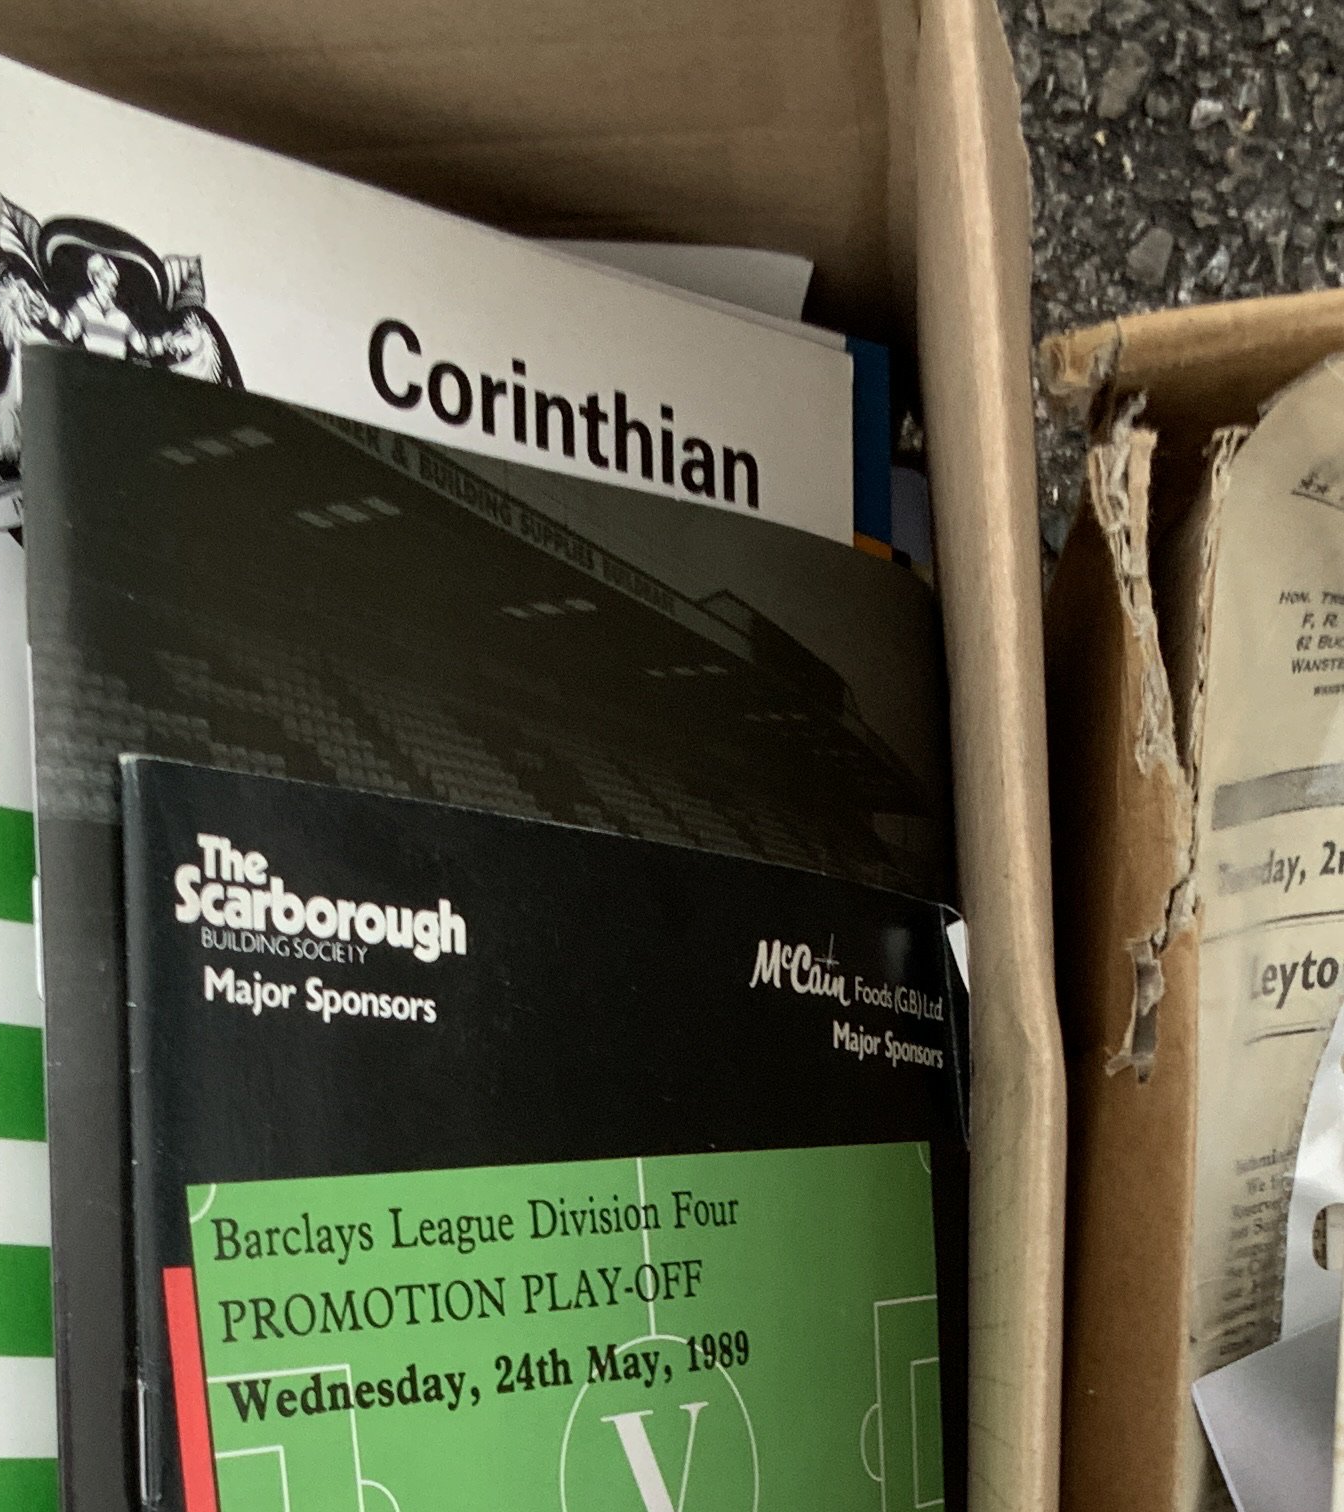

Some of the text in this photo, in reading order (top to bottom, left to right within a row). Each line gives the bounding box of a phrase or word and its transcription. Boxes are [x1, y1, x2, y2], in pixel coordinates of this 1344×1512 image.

[368, 317, 760, 509] Corinthian
[197, 833, 269, 884] The
[174, 863, 467, 963] Scarborough
[201, 926, 369, 964] BUILDING SOCIETY
[204, 965, 437, 1024] Major Sponsors
[749, 938, 851, 1006] McCain
[855, 976, 893, 1010] Foods
[833, 1020, 944, 1069] Major Sponsors
[211, 1190, 740, 1264] Barclays League Division Four
[220, 1259, 704, 1343] PROMOTION PLAY-OFF
[227, 1329, 751, 1423] Wednesday, 24th May, 1989
